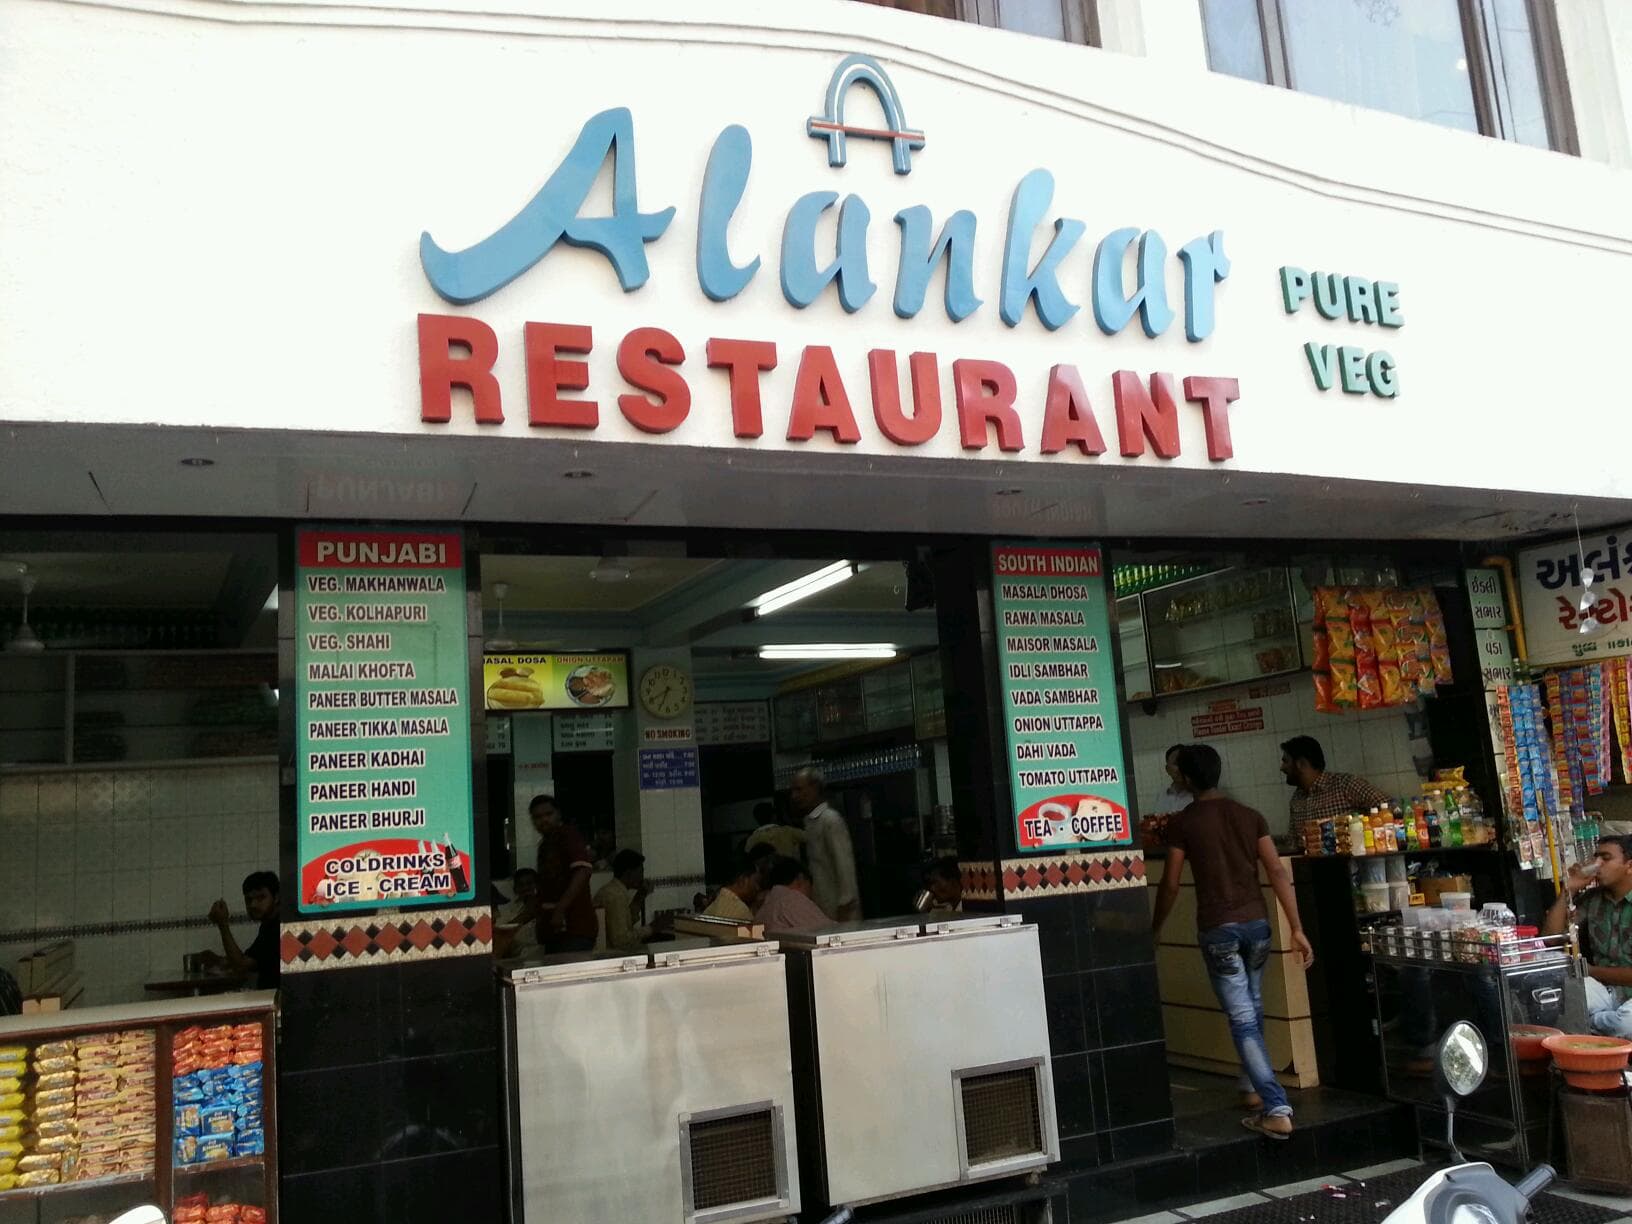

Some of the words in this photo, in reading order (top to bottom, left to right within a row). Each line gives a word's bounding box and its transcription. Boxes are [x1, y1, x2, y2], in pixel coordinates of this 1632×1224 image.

[419, 106, 1232, 343] Alankar
[1278, 265, 1405, 329] PURE
[1303, 341, 1400, 399] VEG
[417, 312, 1240, 462] RESTAURANT
[317, 541, 446, 564] PUNJABI
[998, 554, 1047, 572] SOUTH
[1051, 556, 1098, 573] INDIAN
[308, 576, 342, 592] VEG.
[345, 576, 445, 593] MAKHANWALA
[1002, 585, 1047, 599] MASALA
[1050, 586, 1088, 600] DHOSA
[308, 605, 342, 621] VEG.
[346, 605, 427, 621] KOLHAPURI
[1005, 611, 1037, 625] RAWA
[1040, 612, 1085, 625] MASALA
[308, 634, 342, 650] VEG.
[346, 634, 390, 650] SHAHI
[1007, 638, 1050, 652] MAISOR
[1053, 637, 1097, 651] MASALA
[517, 656, 547, 664] DOSA
[309, 664, 353, 680] MALAI
[358, 662, 415, 679] KHOFTA
[1010, 664, 1031, 678] IDLI
[1034, 663, 1088, 678] SAMBHAR
[309, 692, 357, 709] PANEER
[360, 691, 406, 707] BUTTER
[410, 689, 457, 705] MASALA
[1012, 691, 1041, 705] VADA
[1045, 690, 1098, 705] SAMBHAR
[309, 722, 357, 739] PANEER
[360, 720, 397, 737] TIKKA
[401, 719, 448, 735] MASALA
[1014, 717, 1050, 732] ONION
[1054, 715, 1103, 731] UTTAPPA
[645, 729, 656, 739] NO
[657, 728, 690, 739] SMOKING
[310, 752, 366, 770] PANEER
[371, 750, 424, 767] KADHAI
[1016, 745, 1044, 759] DAHI
[1047, 743, 1076, 758] VADA
[1019, 771, 1065, 787] TOMATO
[1069, 768, 1118, 784] UTTAPPA
[310, 783, 367, 801] PANEER
[371, 780, 416, 797] HANDI
[310, 813, 367, 832] PANEER
[372, 810, 425, 828] BHURJI
[1024, 820, 1052, 838] TEA
[1071, 815, 1122, 834] COFFEE
[325, 853, 445, 874] COLDRINKS
[326, 881, 360, 897] ICE
[379, 874, 450, 893] CREAM
